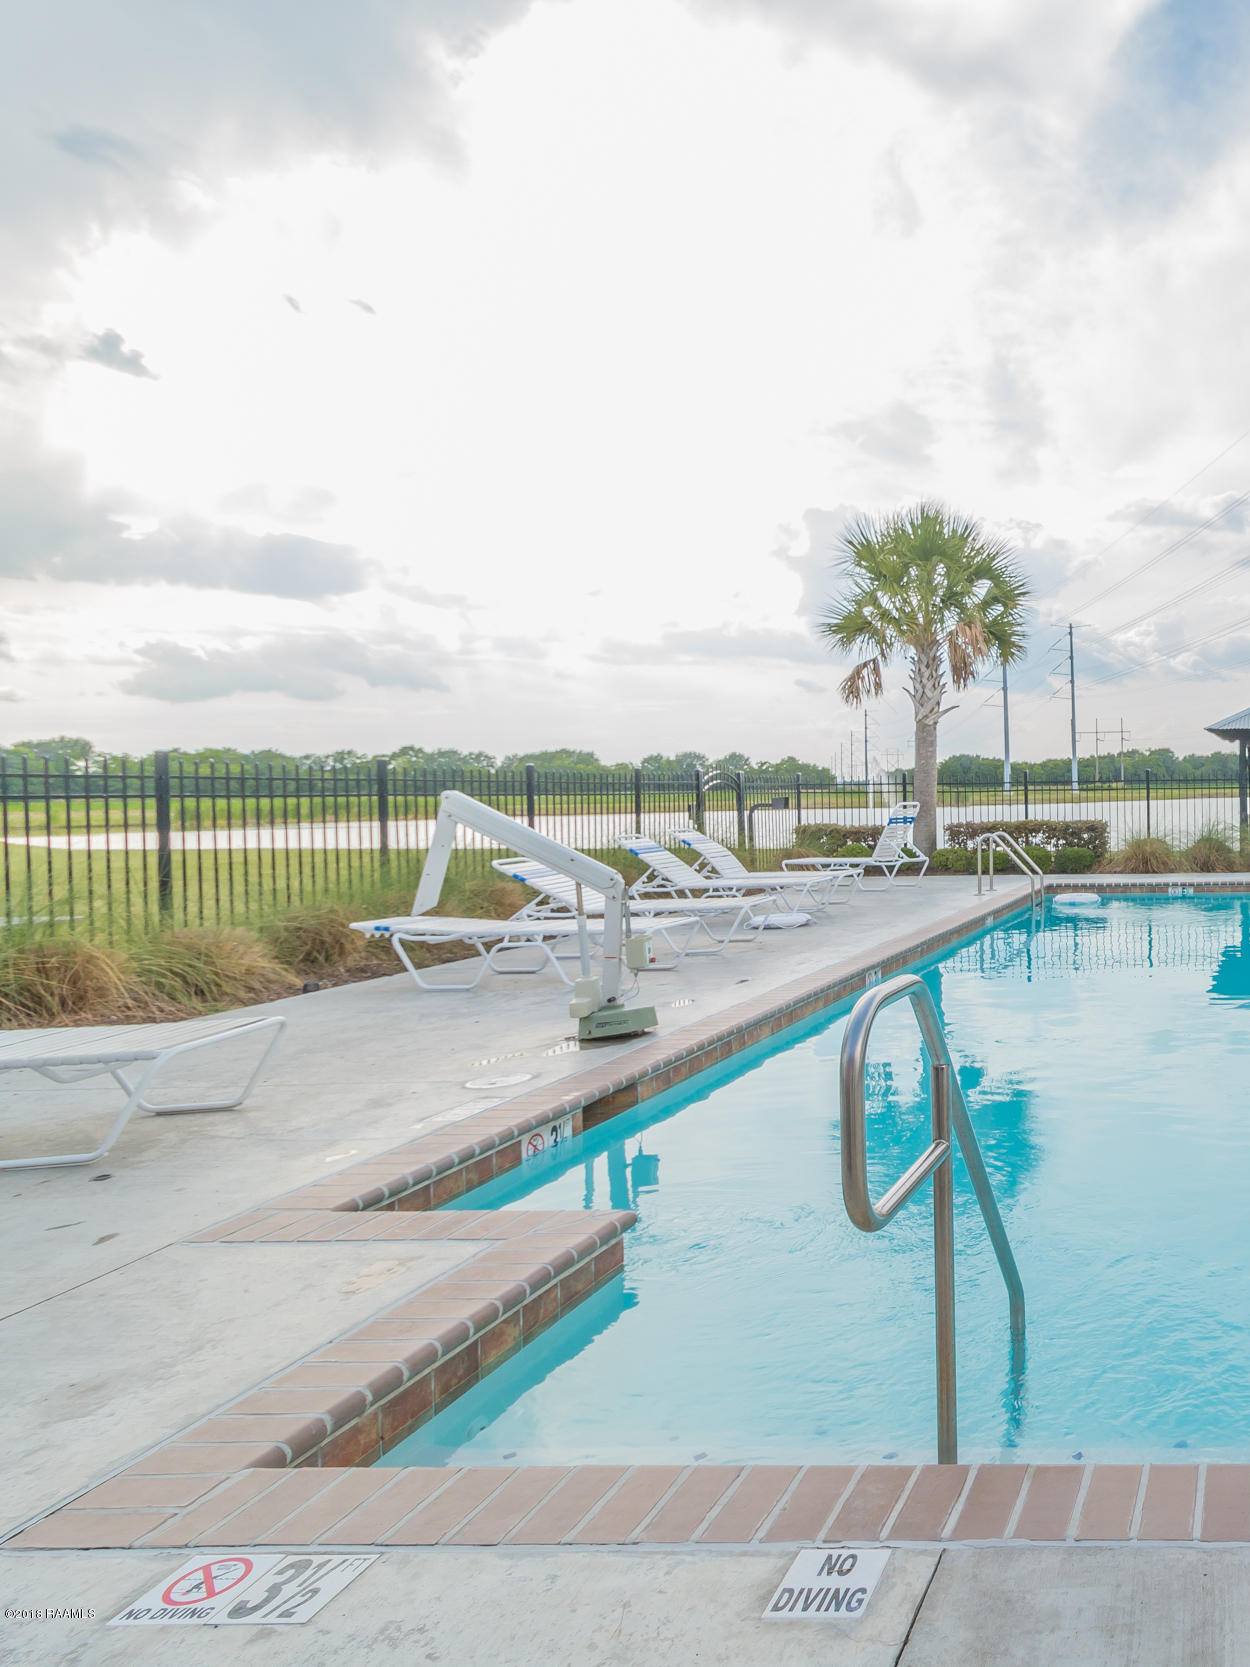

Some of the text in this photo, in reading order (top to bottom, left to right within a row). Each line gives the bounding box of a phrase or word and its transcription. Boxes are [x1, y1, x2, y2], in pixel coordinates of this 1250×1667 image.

[816, 1553, 858, 1577] NO
[770, 1587, 868, 1613] DIVING
[119, 1607, 216, 1620] NO DIVING
